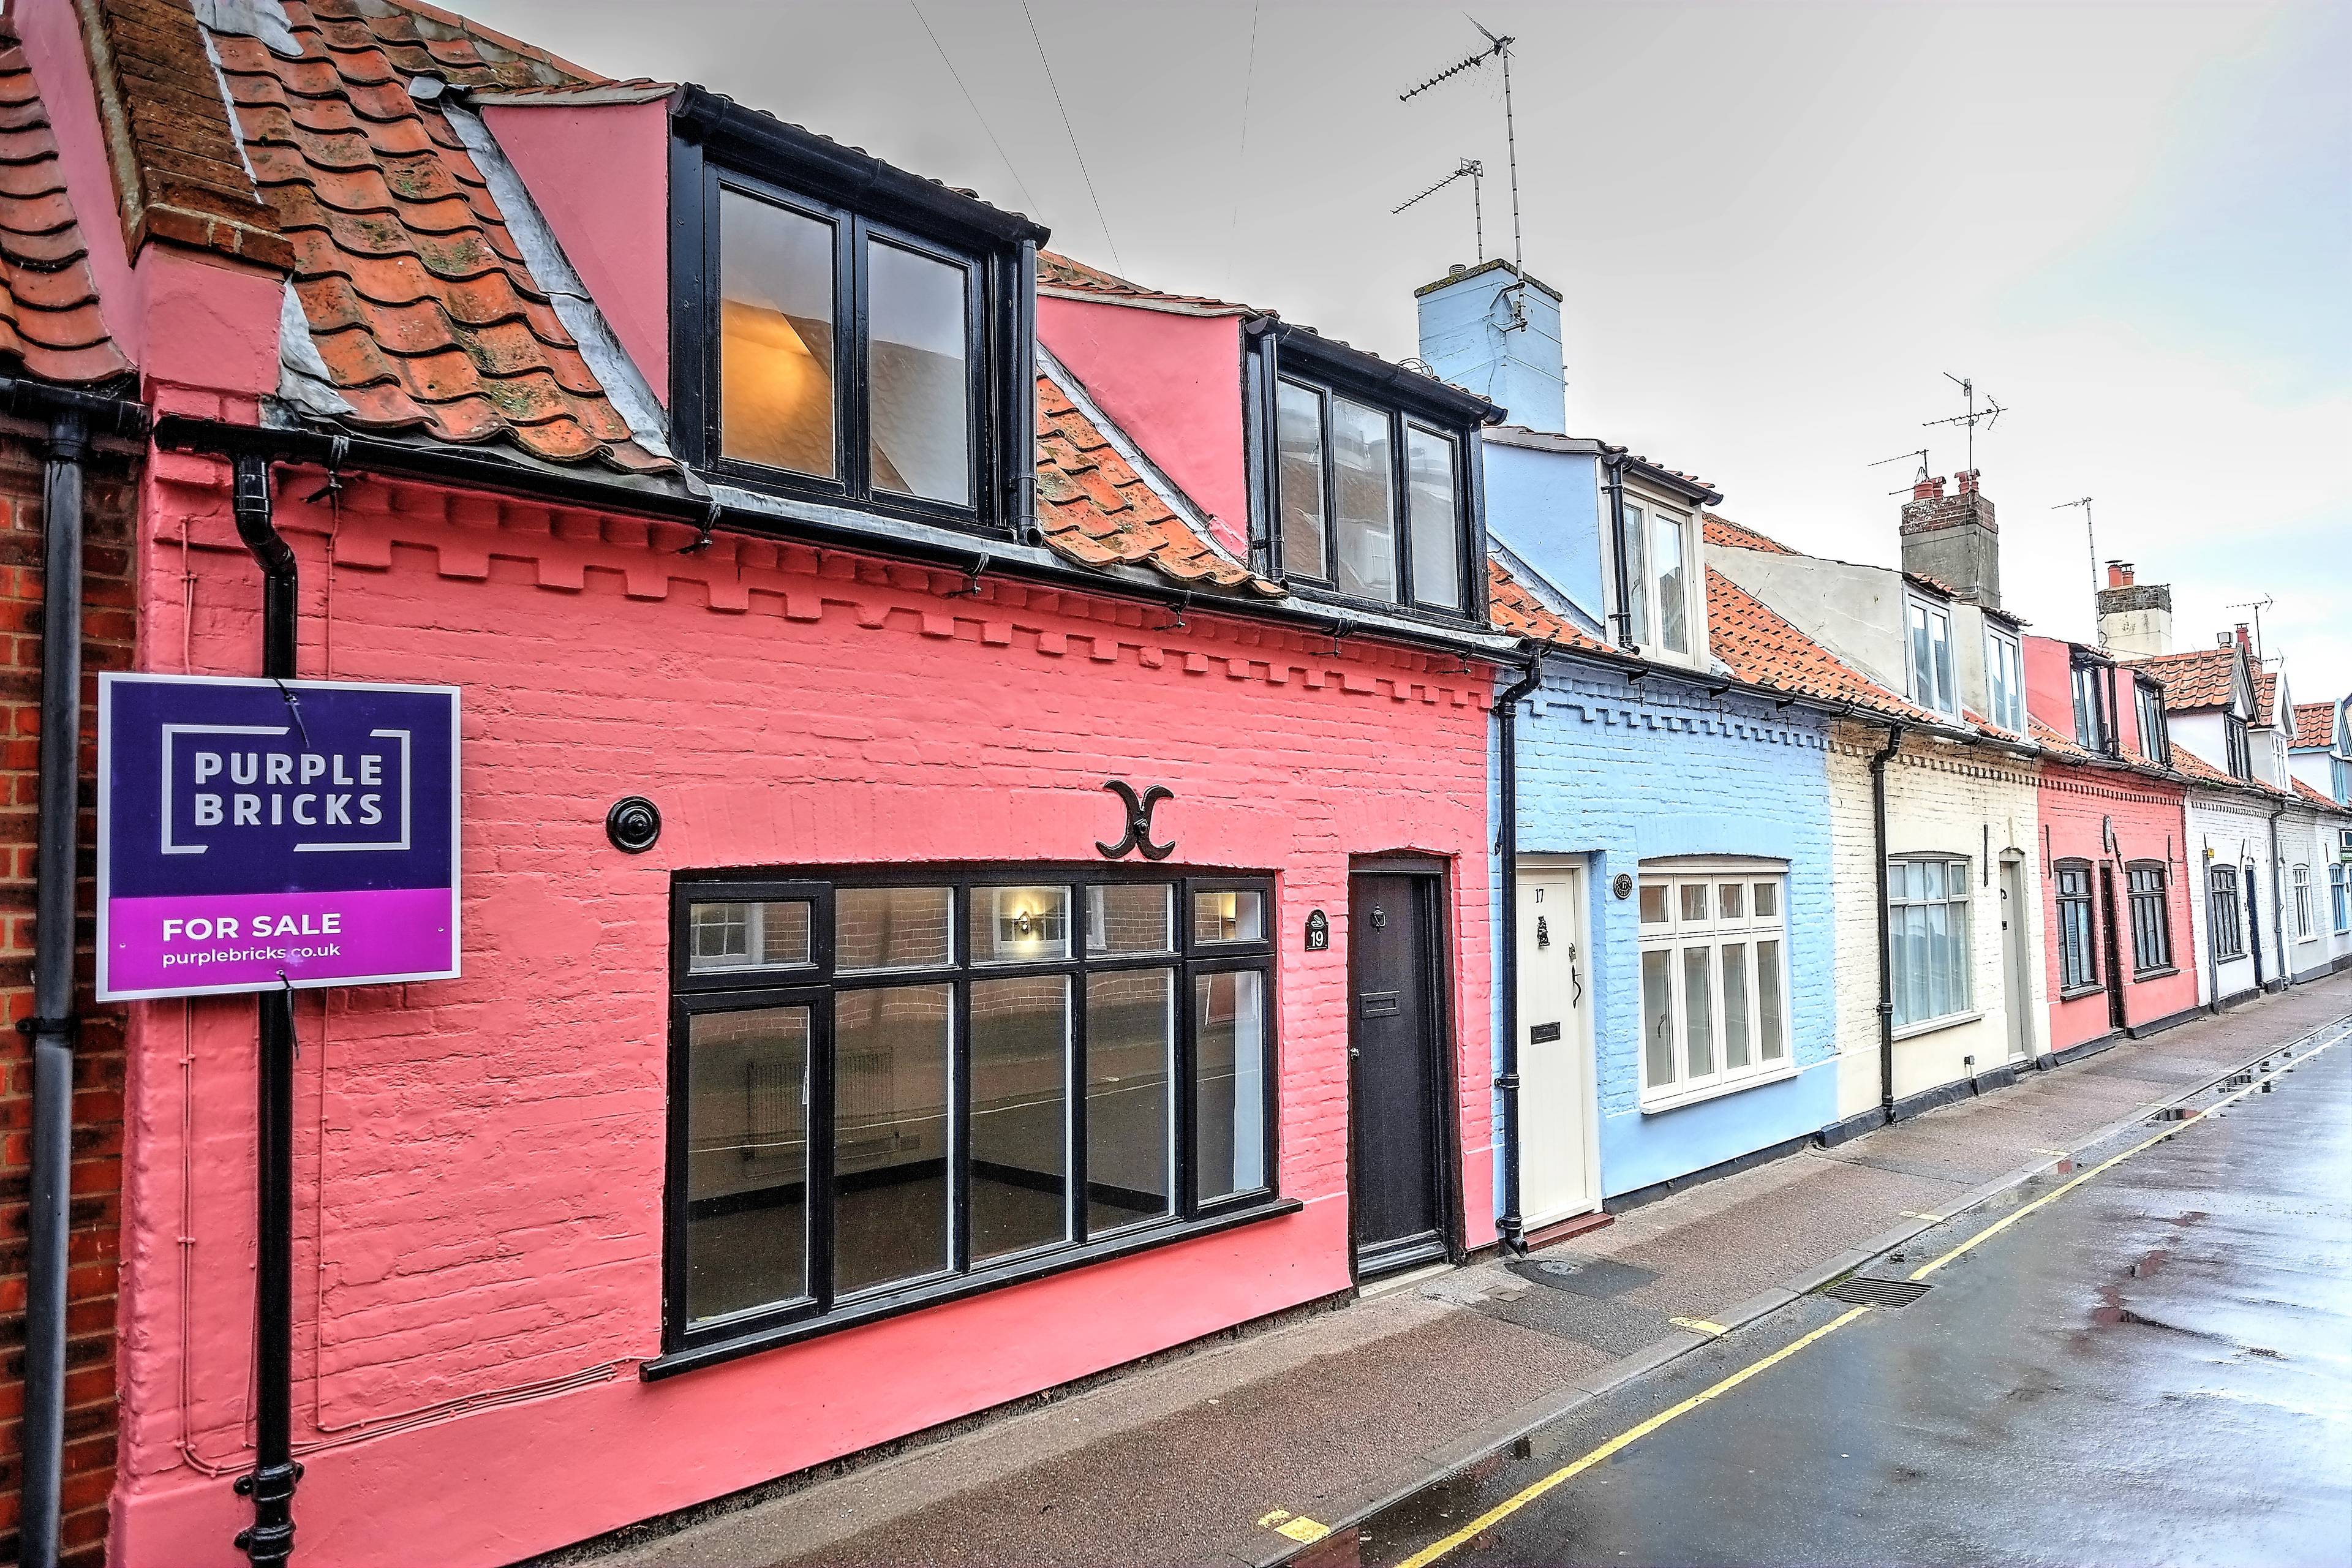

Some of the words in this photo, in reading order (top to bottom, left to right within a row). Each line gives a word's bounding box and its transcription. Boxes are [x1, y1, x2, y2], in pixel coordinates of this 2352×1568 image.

[195, 752, 382, 785] PURPLE
[195, 794, 382, 826] BRICKS
[1536, 888, 1544, 903] 17
[162, 918, 239, 941] FOR
[252, 913, 341, 937] SALE
[1311, 930, 1323, 947] 19
